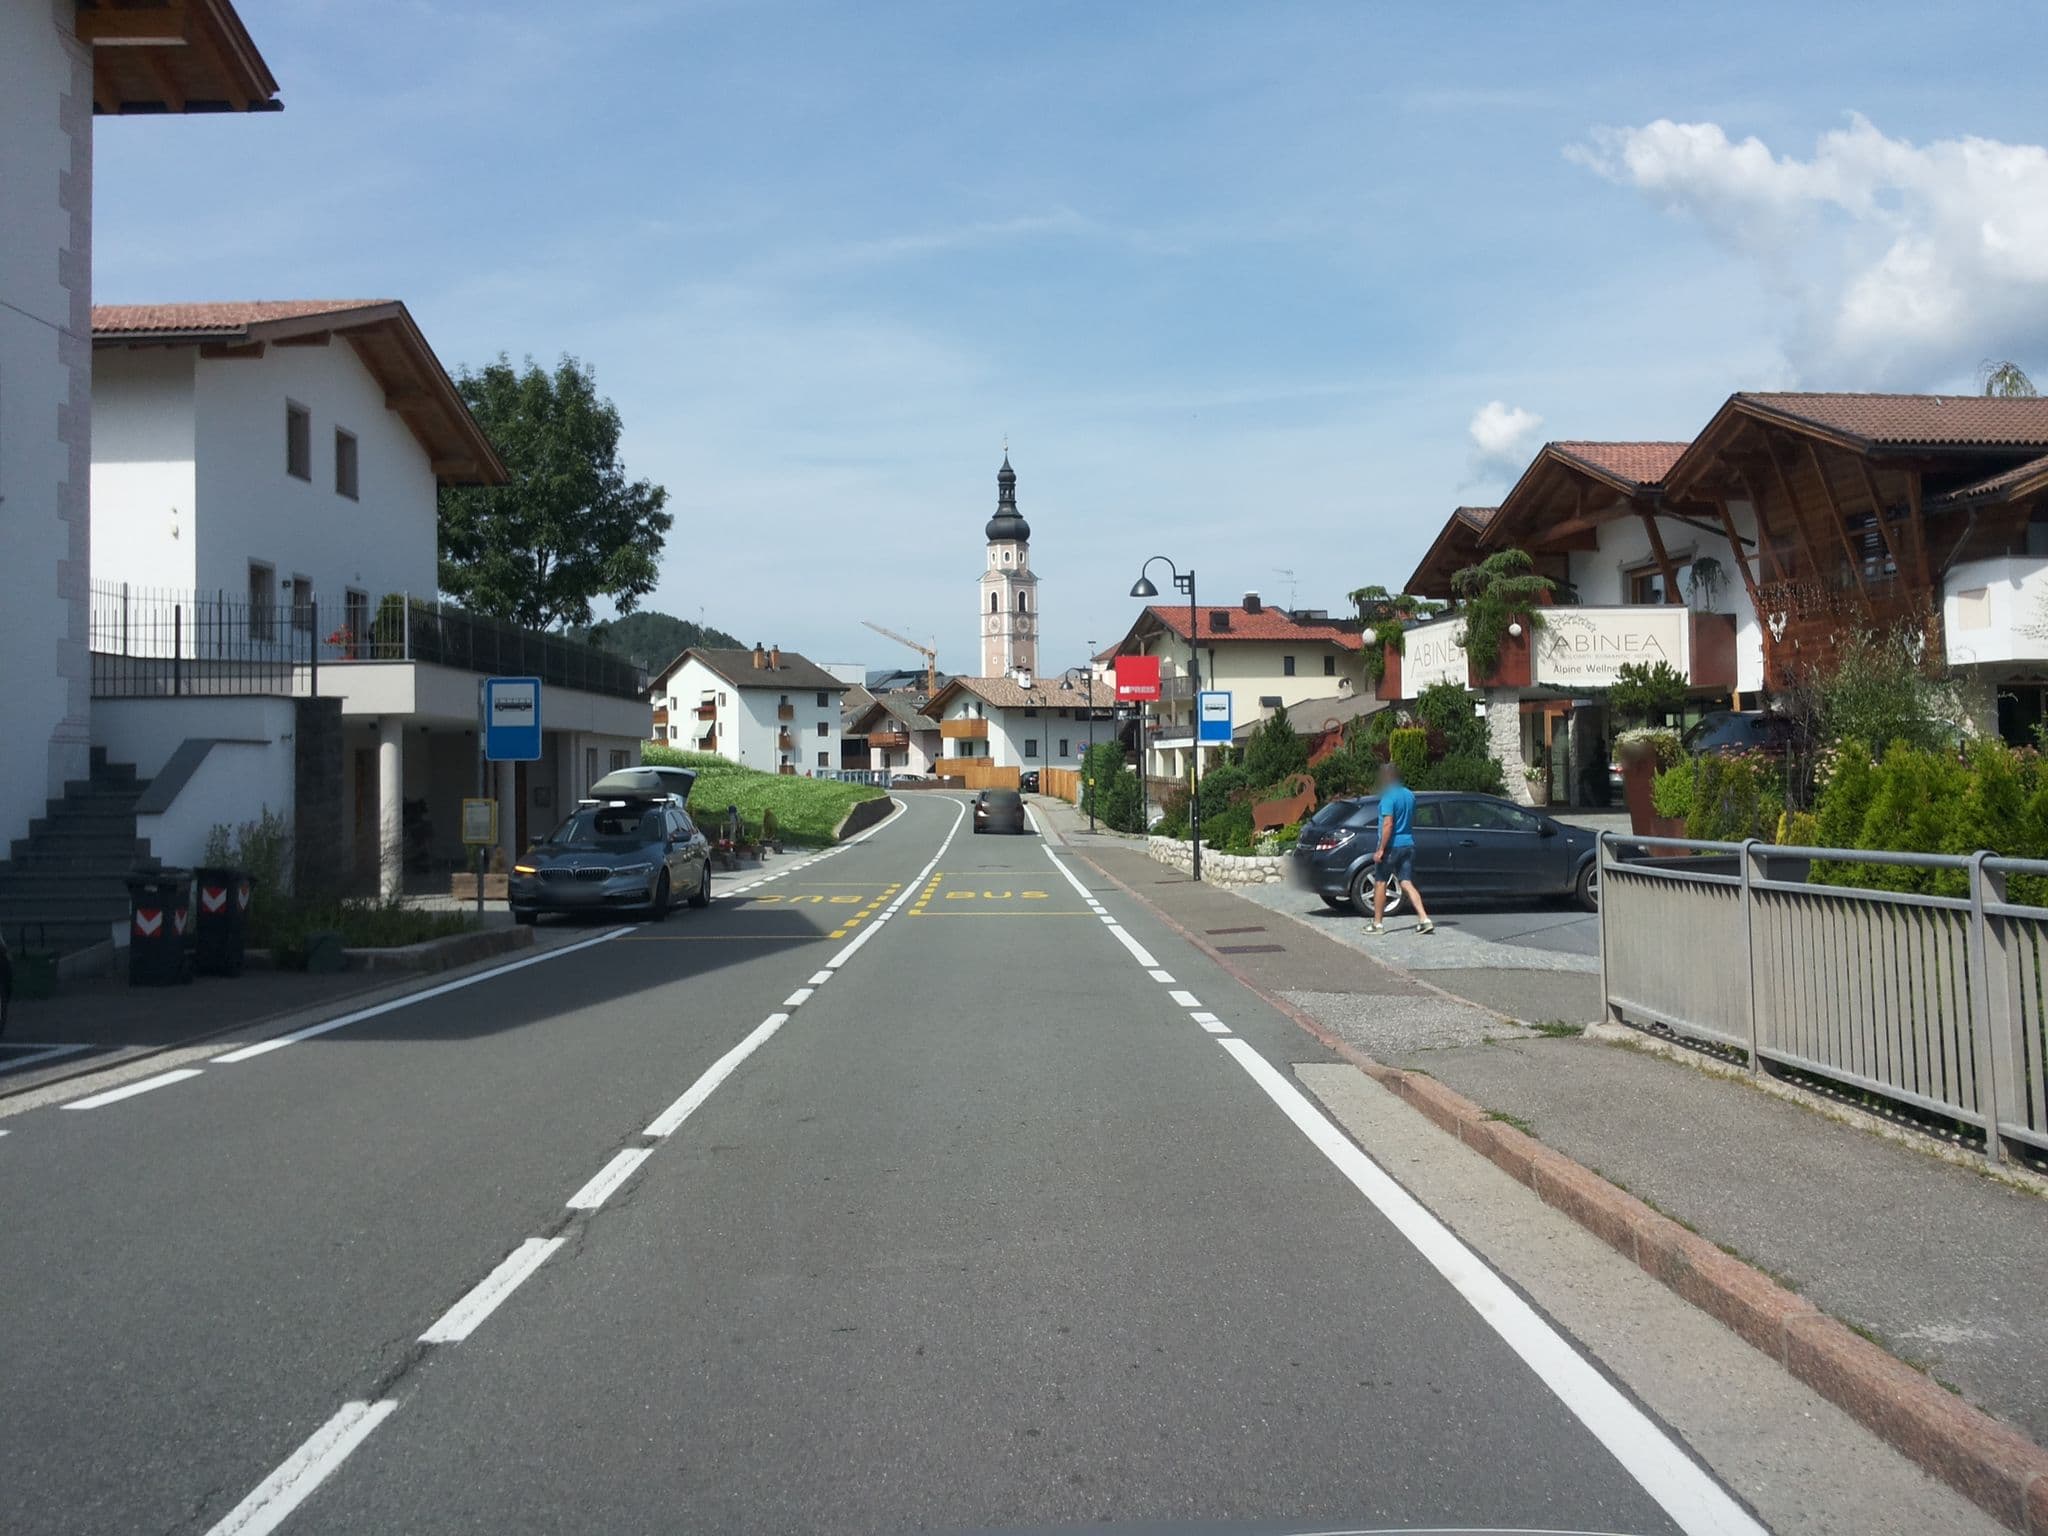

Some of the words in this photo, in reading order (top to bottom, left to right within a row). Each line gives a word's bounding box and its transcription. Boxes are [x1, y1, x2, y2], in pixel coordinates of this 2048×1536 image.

[1546, 633, 1666, 659] ABINEA
[1553, 663, 1582, 675] Alpine
[944, 890, 1049, 900] BUS
